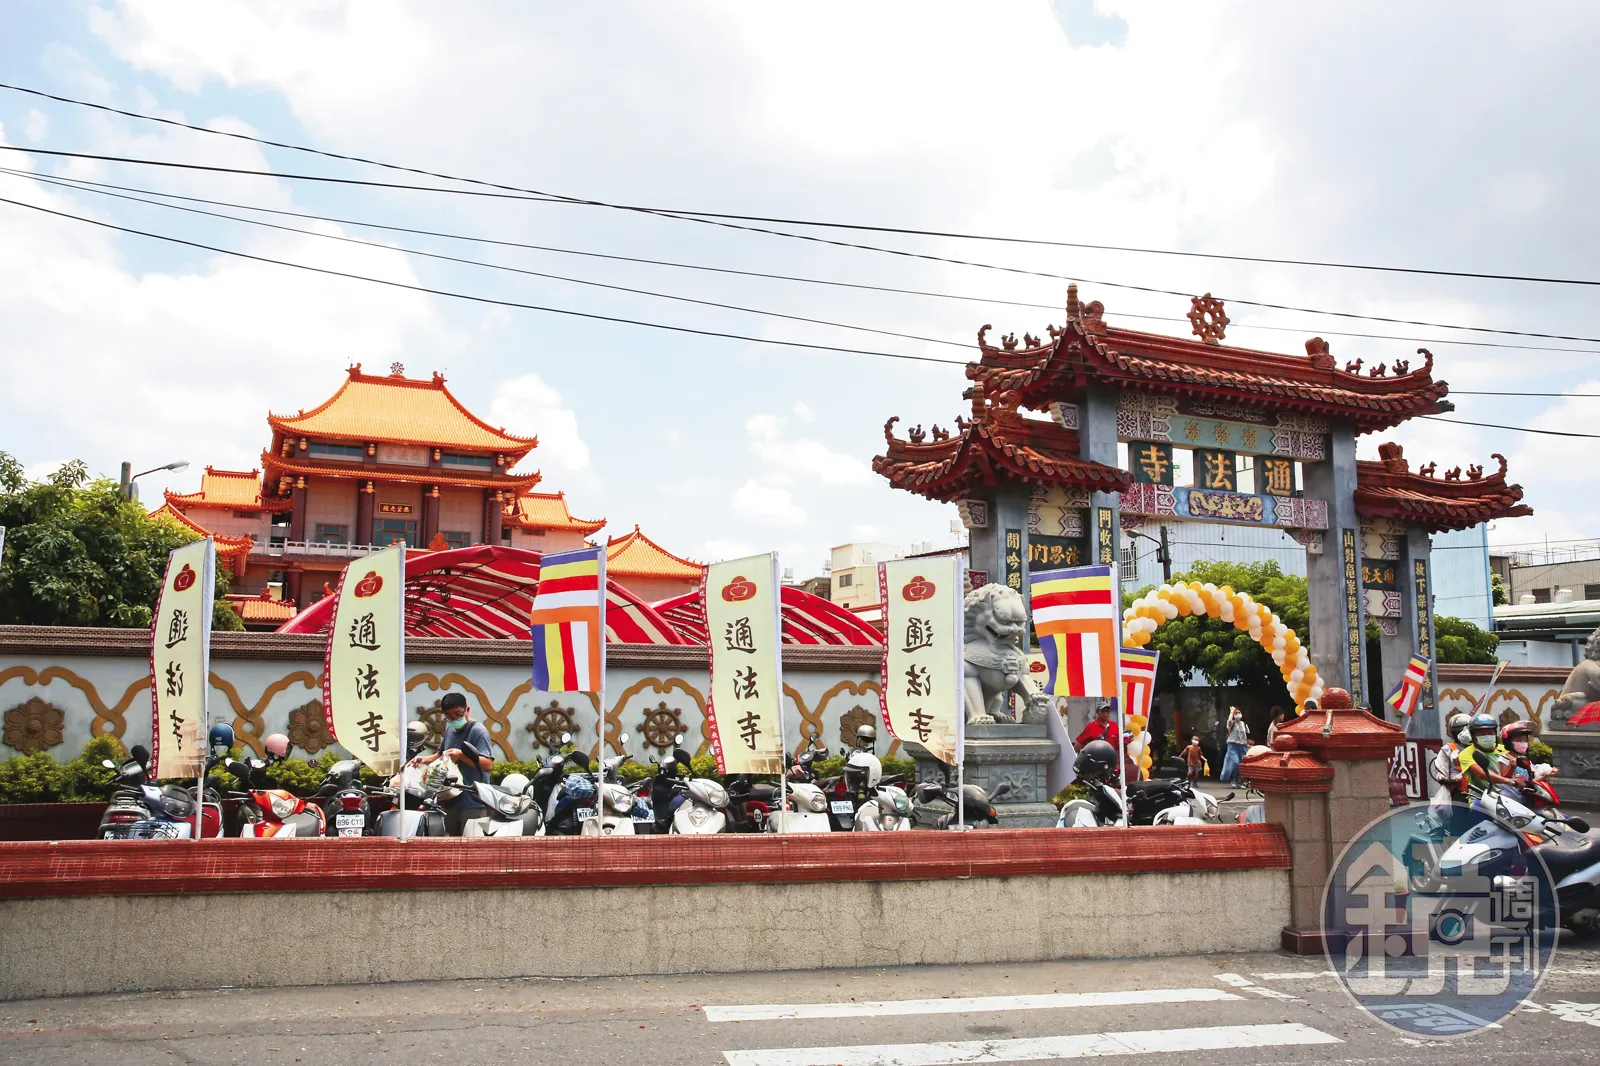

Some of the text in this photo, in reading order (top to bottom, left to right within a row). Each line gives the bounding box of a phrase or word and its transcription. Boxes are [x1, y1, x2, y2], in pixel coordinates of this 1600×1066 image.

[349, 612, 387, 752] 通法寺
[724, 616, 762, 751] 通法寺
